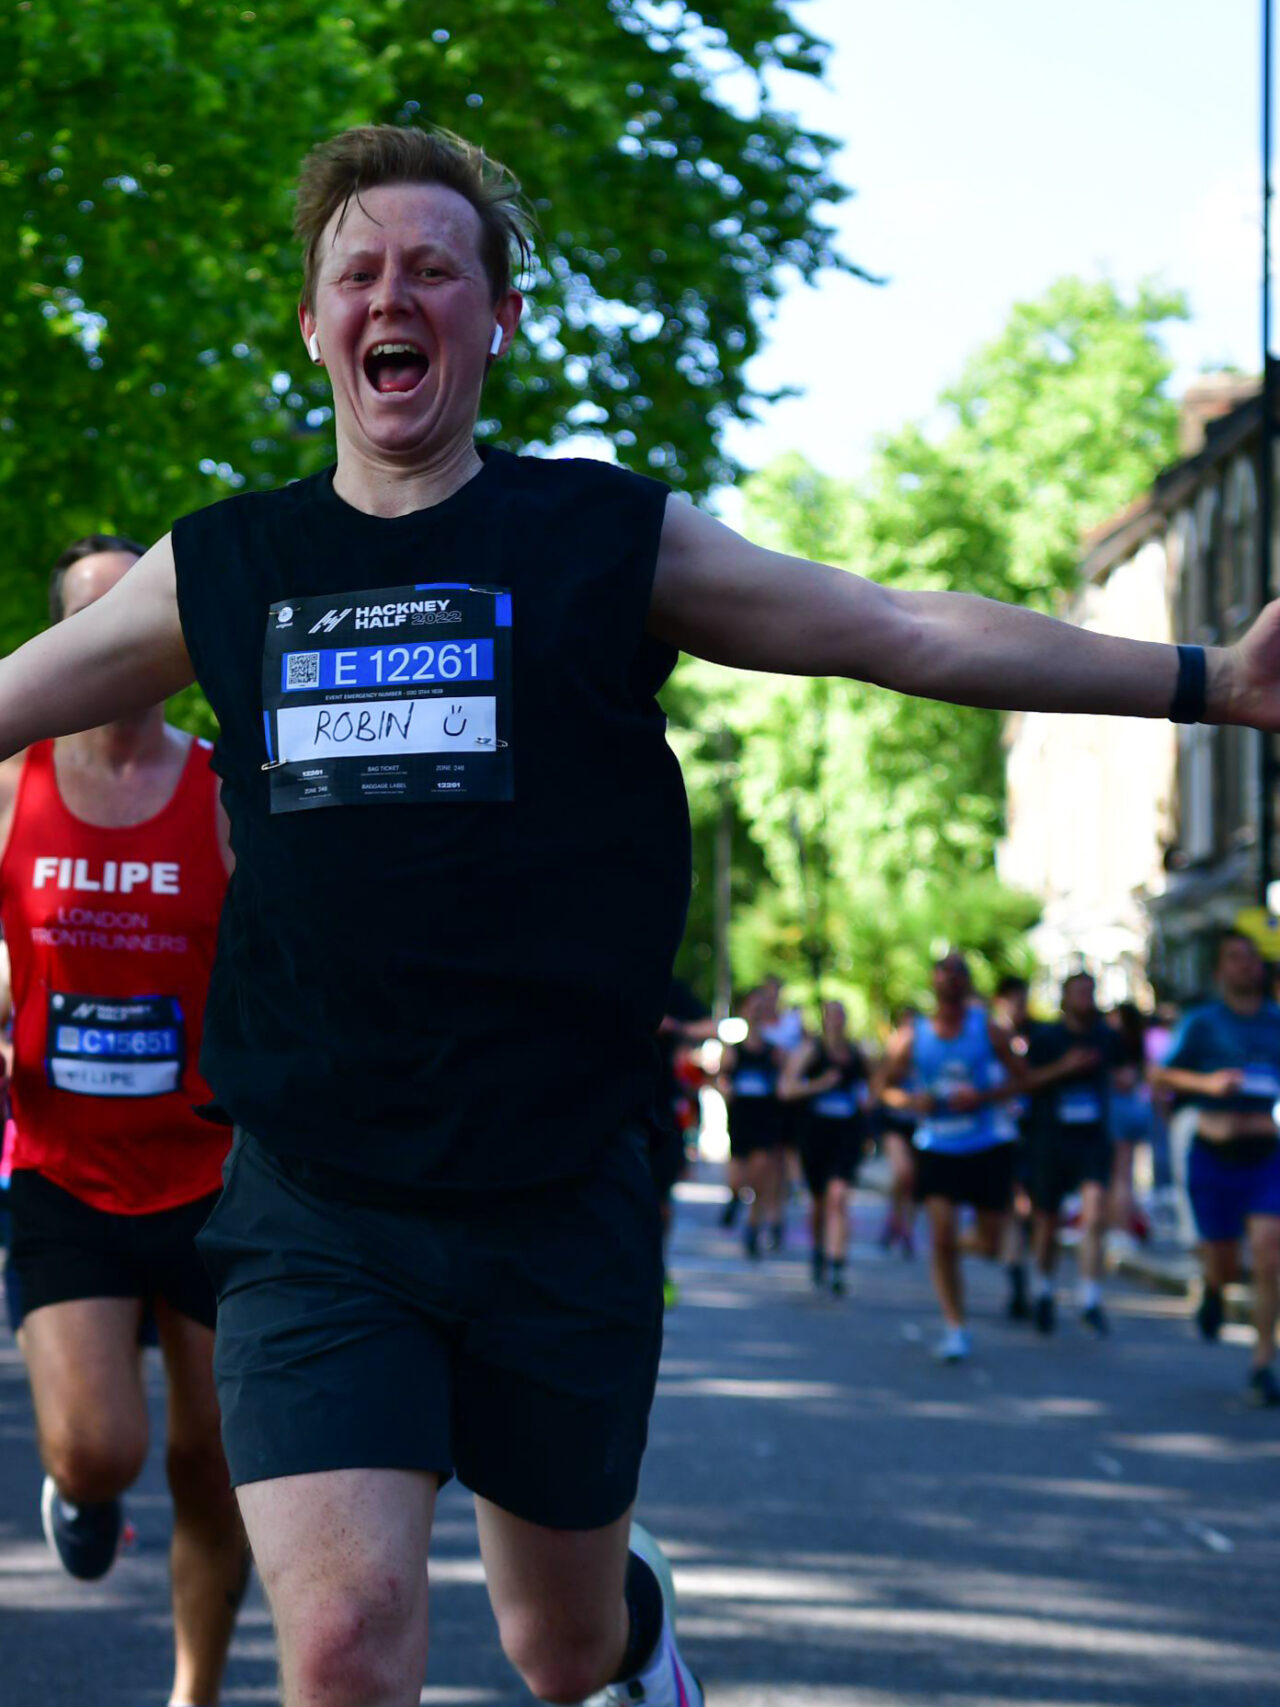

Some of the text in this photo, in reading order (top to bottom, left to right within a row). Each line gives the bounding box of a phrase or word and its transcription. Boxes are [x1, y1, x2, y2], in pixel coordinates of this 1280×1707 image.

[355, 599, 451, 618] HACKNEY
[355, 611, 463, 630] HALF 2022
[334, 643, 478, 685] E 12261
[313, 701, 415, 746] ROBIN
[33, 857, 180, 895] FILIPE
[57, 907, 148, 928] LONDON
[31, 927, 187, 951] FRONTRUNNERS
[82, 1029, 101, 1053] C
